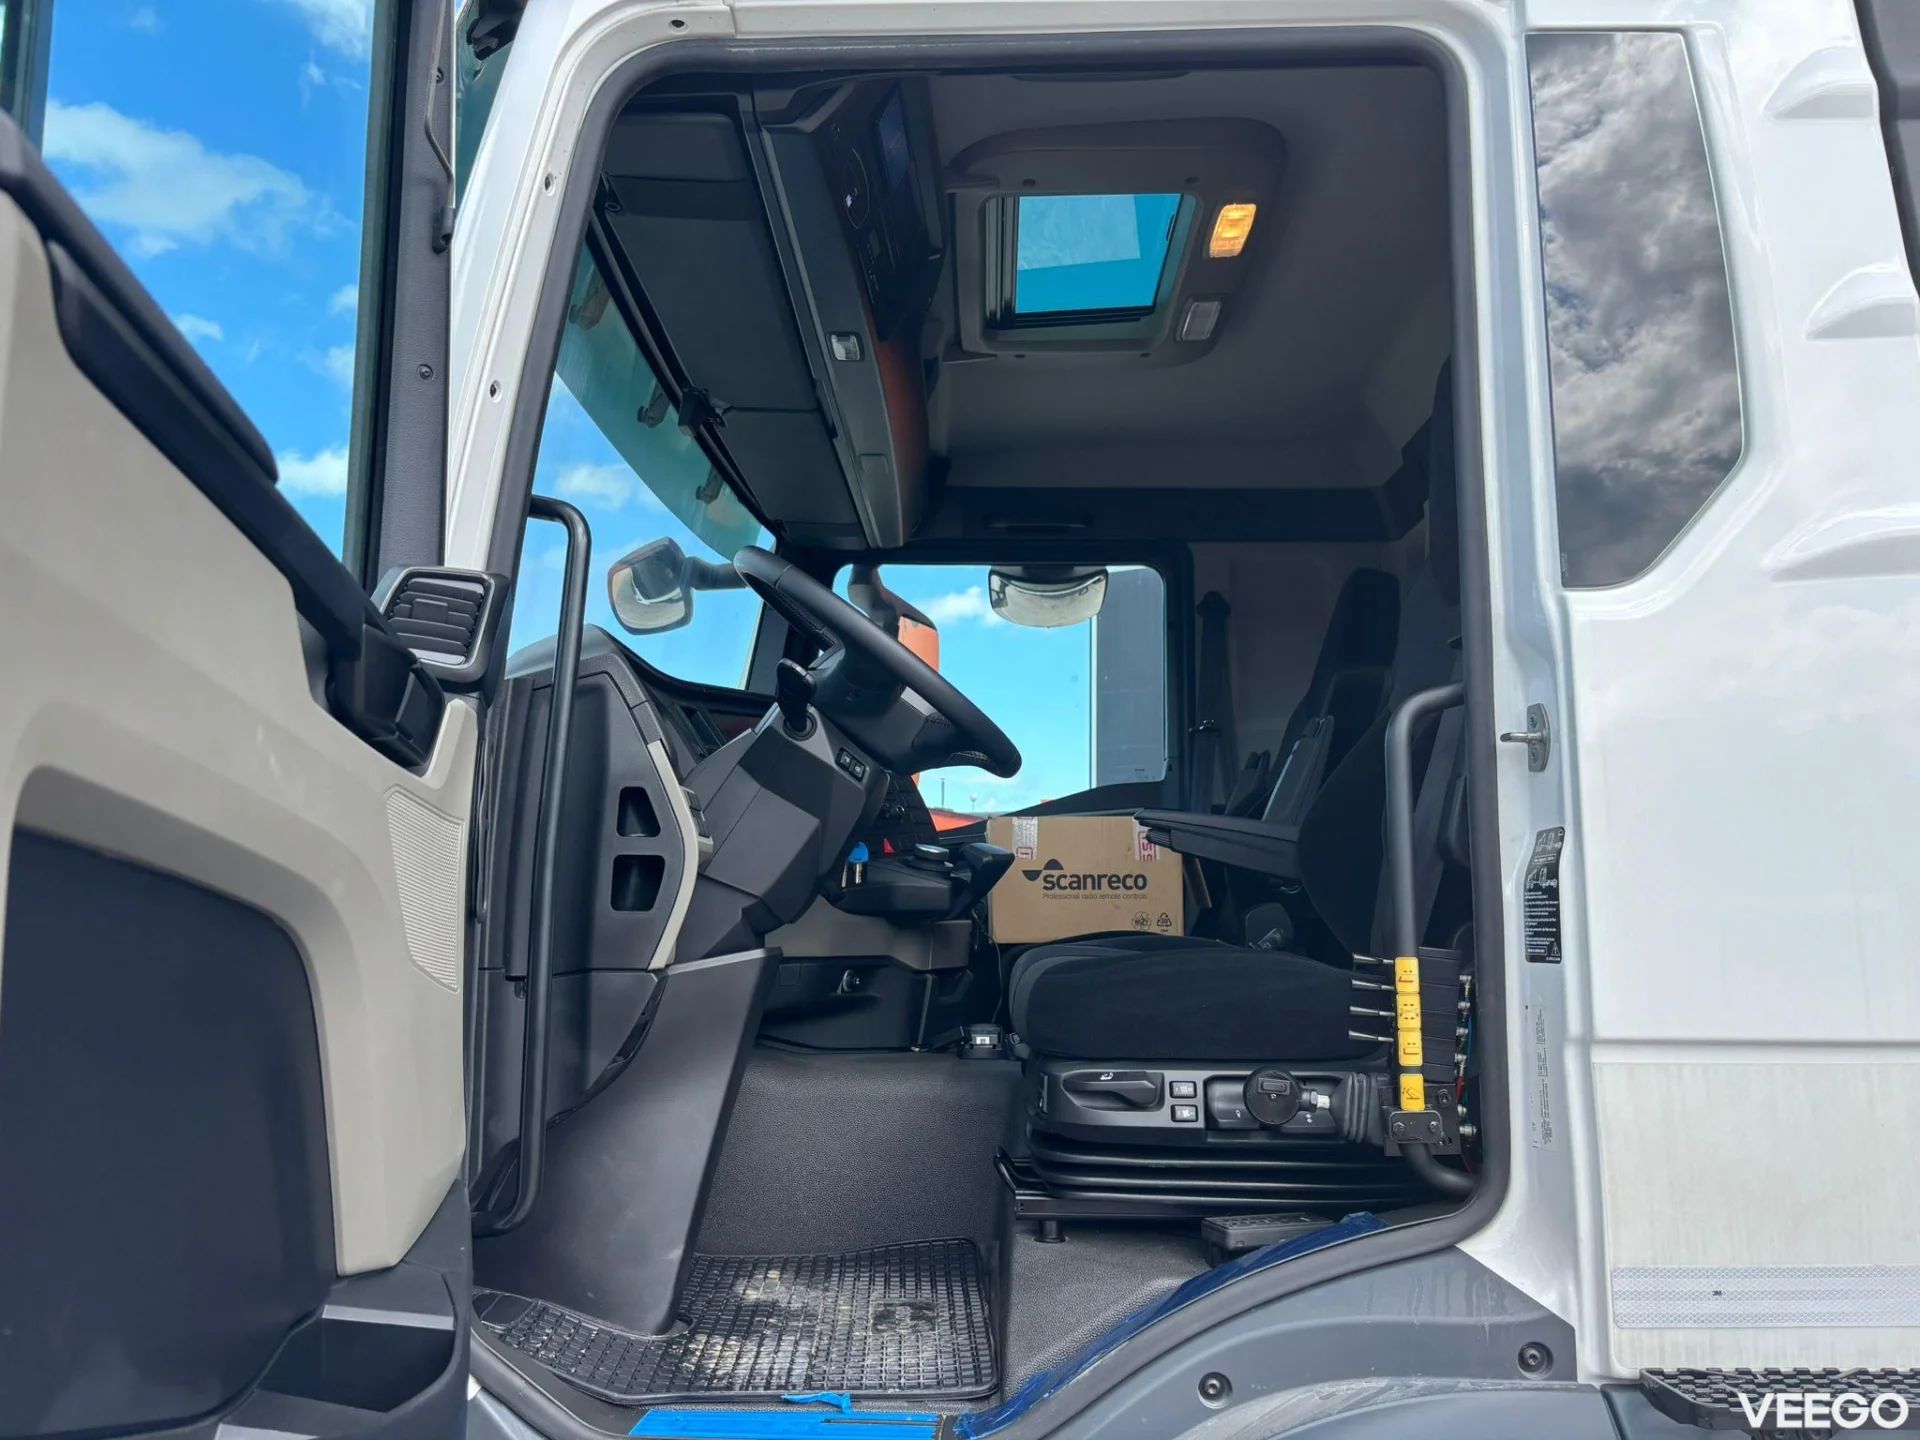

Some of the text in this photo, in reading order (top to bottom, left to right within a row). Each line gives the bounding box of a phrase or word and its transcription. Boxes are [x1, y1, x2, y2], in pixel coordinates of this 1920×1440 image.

[1042, 873, 1148, 891] scanreco
[1042, 892, 1080, 900] Professional
[1081, 892, 1098, 900] radio
[1099, 892, 1121, 900] remote
